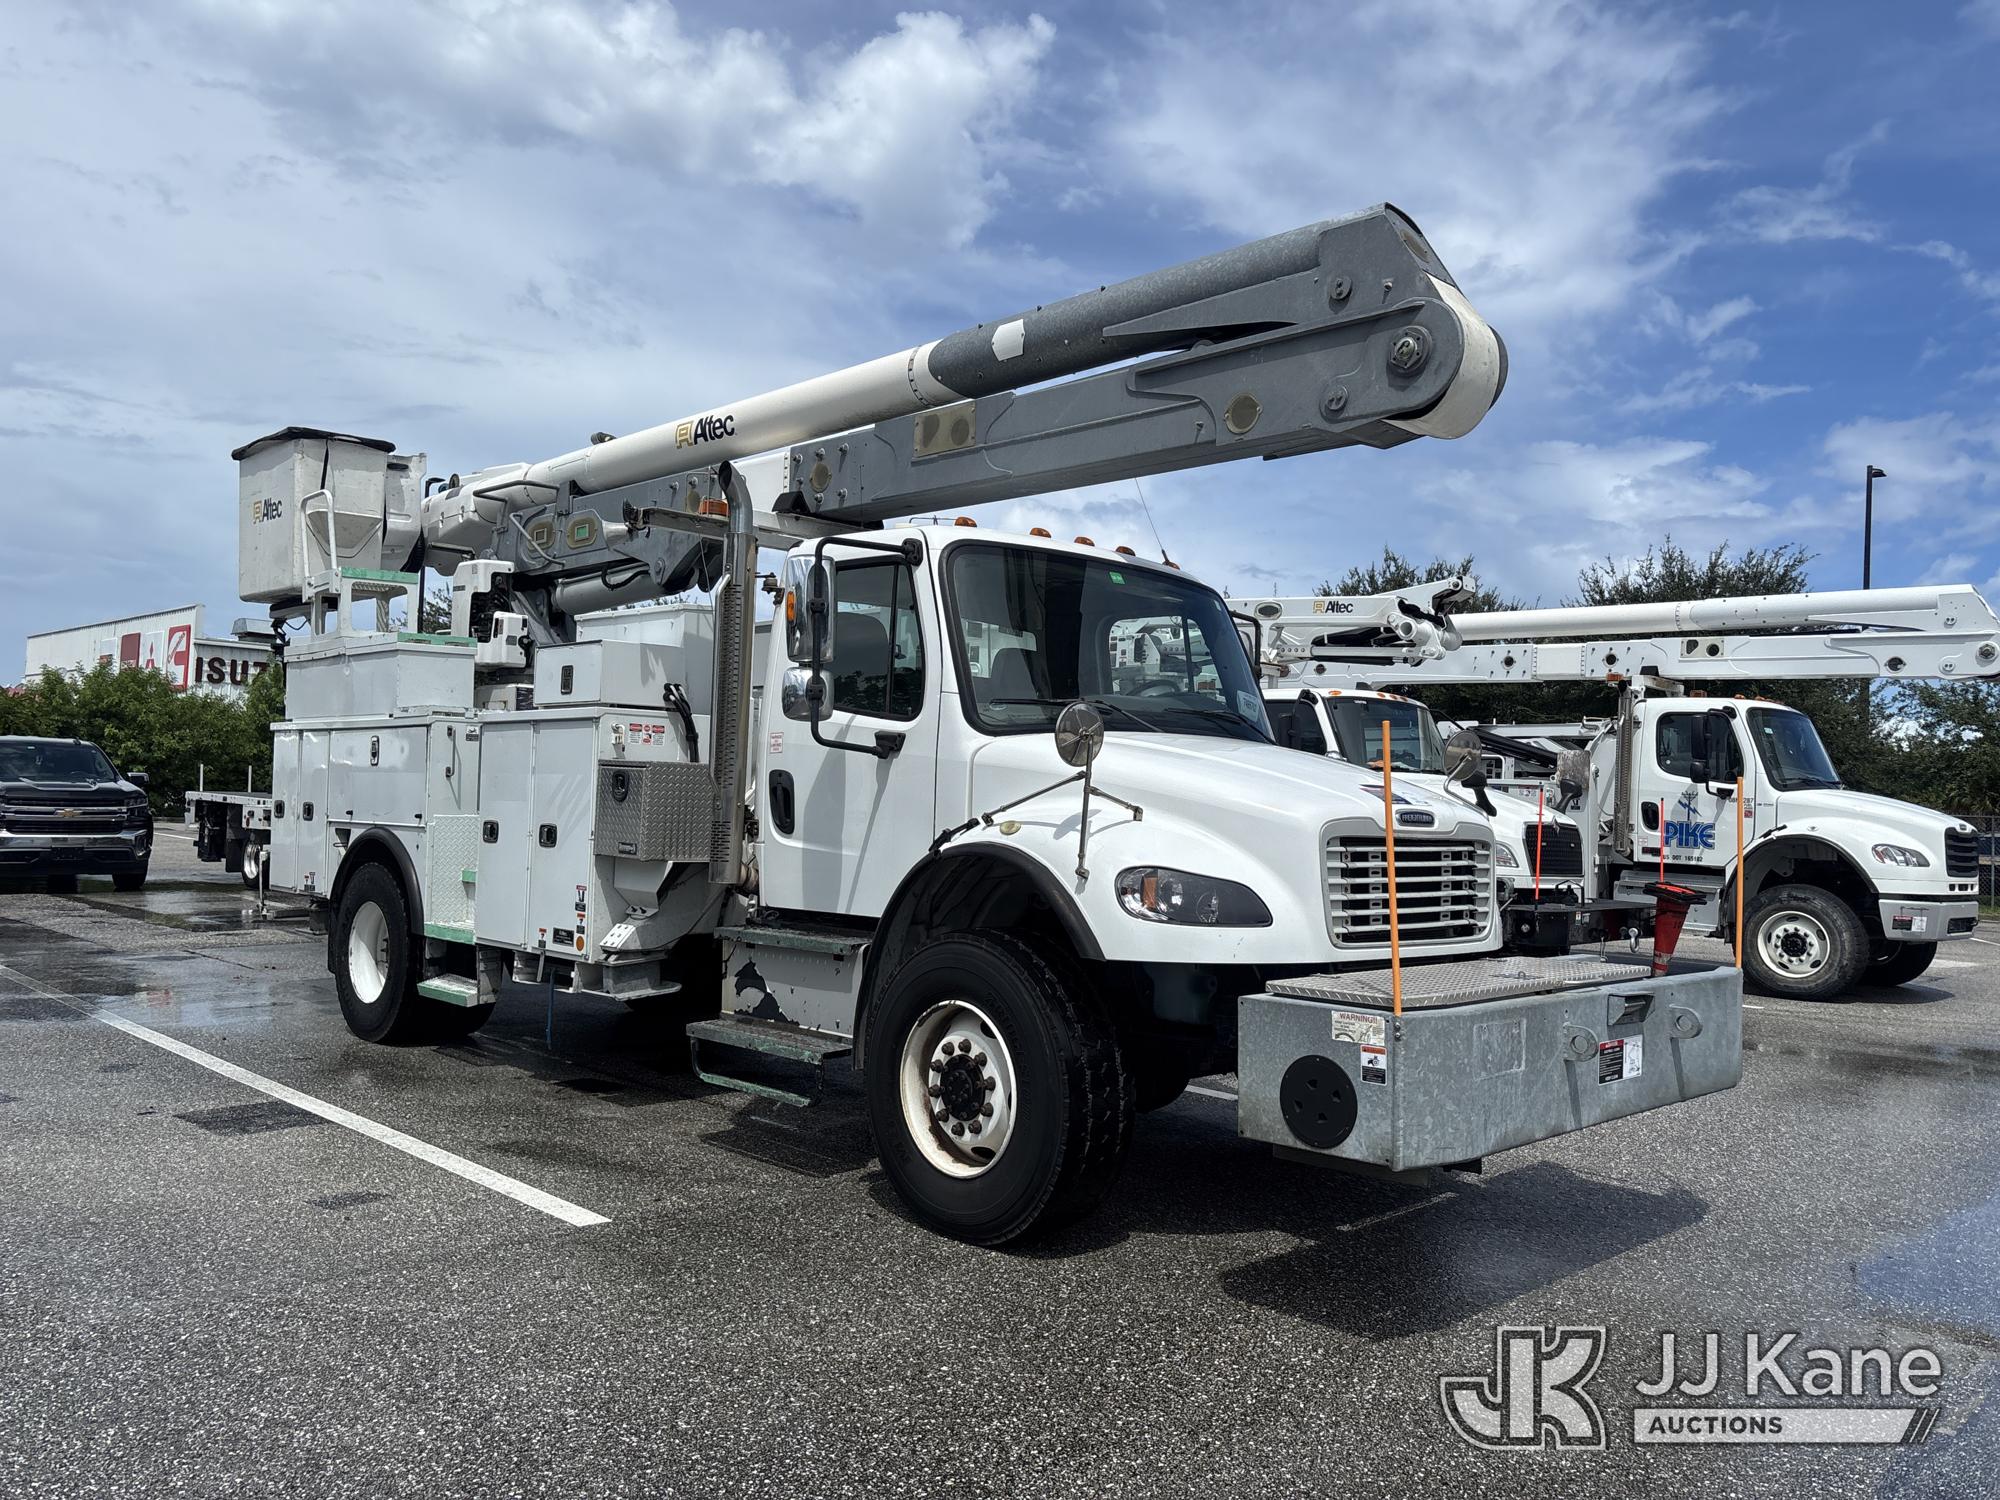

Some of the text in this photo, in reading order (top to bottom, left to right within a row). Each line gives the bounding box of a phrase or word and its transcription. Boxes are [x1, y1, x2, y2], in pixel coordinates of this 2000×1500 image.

[694, 415, 735, 445] Altec
[262, 498, 282, 522] Altec
[1325, 601, 1353, 613] Altec
[1664, 820, 1715, 849] PIKE
